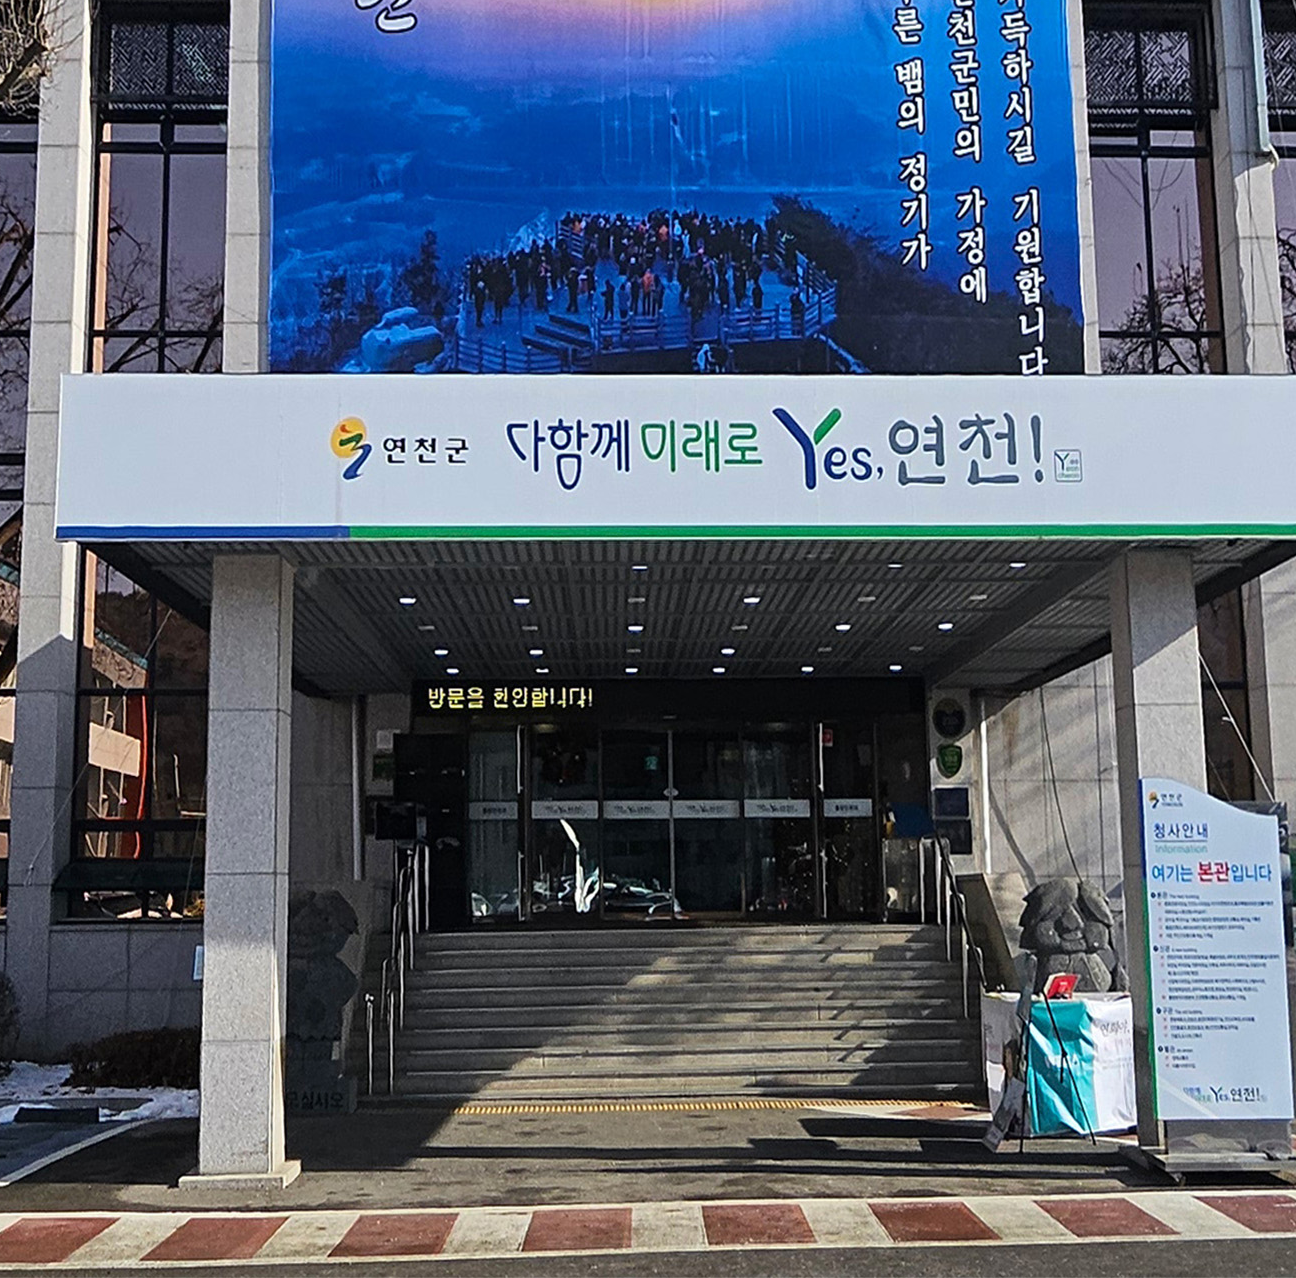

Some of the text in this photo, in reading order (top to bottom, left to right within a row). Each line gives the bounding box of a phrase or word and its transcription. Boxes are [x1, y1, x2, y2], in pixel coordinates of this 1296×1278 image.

[894, 58, 925, 135] 뱀의
[898, 152, 933, 271] 정기가
[955, 185, 988, 304] 가정에
[1012, 186, 1049, 375] 기원합니다
[382, 407, 1044, 490] 연천군 다함께 미래로 Yes, 연천!
[428, 687, 484, 709] 방문을
[1153, 823, 1208, 838] 청사안내
[1151, 864, 1193, 882] 여기는
